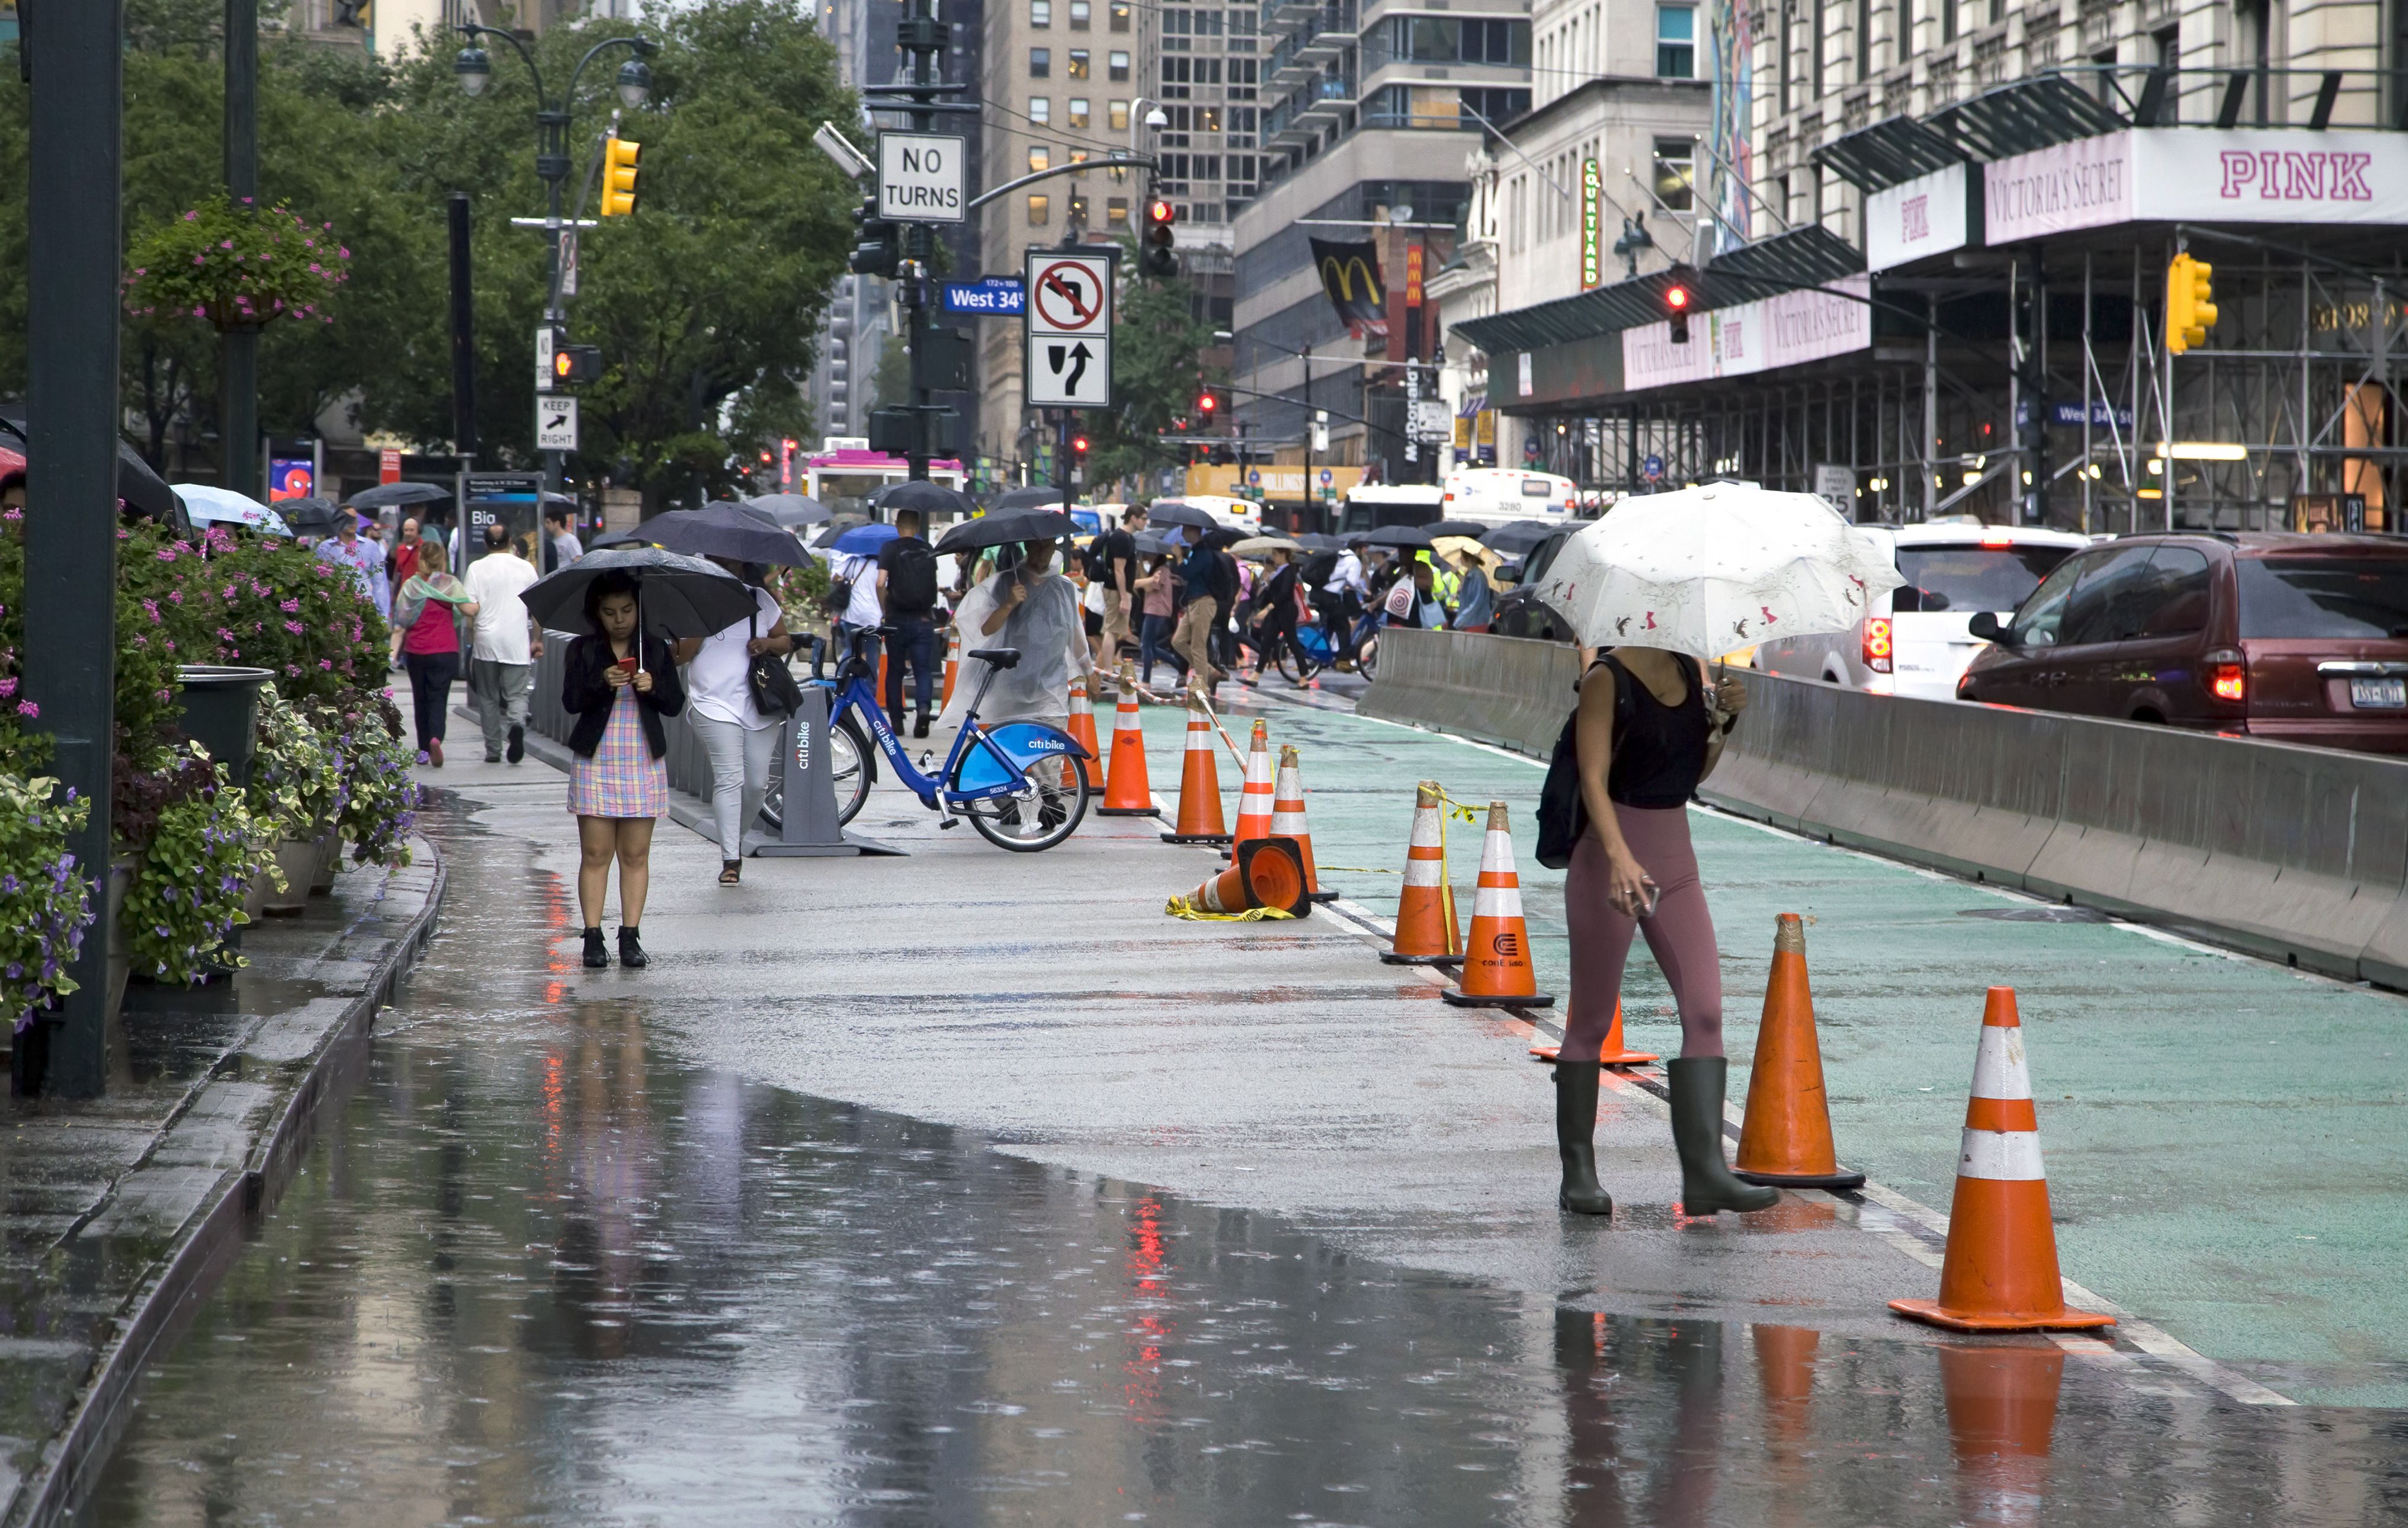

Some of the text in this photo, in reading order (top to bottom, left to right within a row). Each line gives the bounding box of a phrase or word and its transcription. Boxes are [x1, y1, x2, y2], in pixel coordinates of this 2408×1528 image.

[903, 147, 941, 174] NO
[2220, 150, 2372, 201] PINK
[886, 184, 958, 207] TURNS
[1991, 158, 2123, 223] VICTORIA'S SECRET
[1585, 159, 1598, 283] COURTYARD
[951, 289, 995, 308] West
[543, 401, 570, 412] KEEP
[1405, 356, 1419, 462] McDonald's
[540, 434, 572, 444] RIGHT
[989, 786, 1007, 795] 56324
